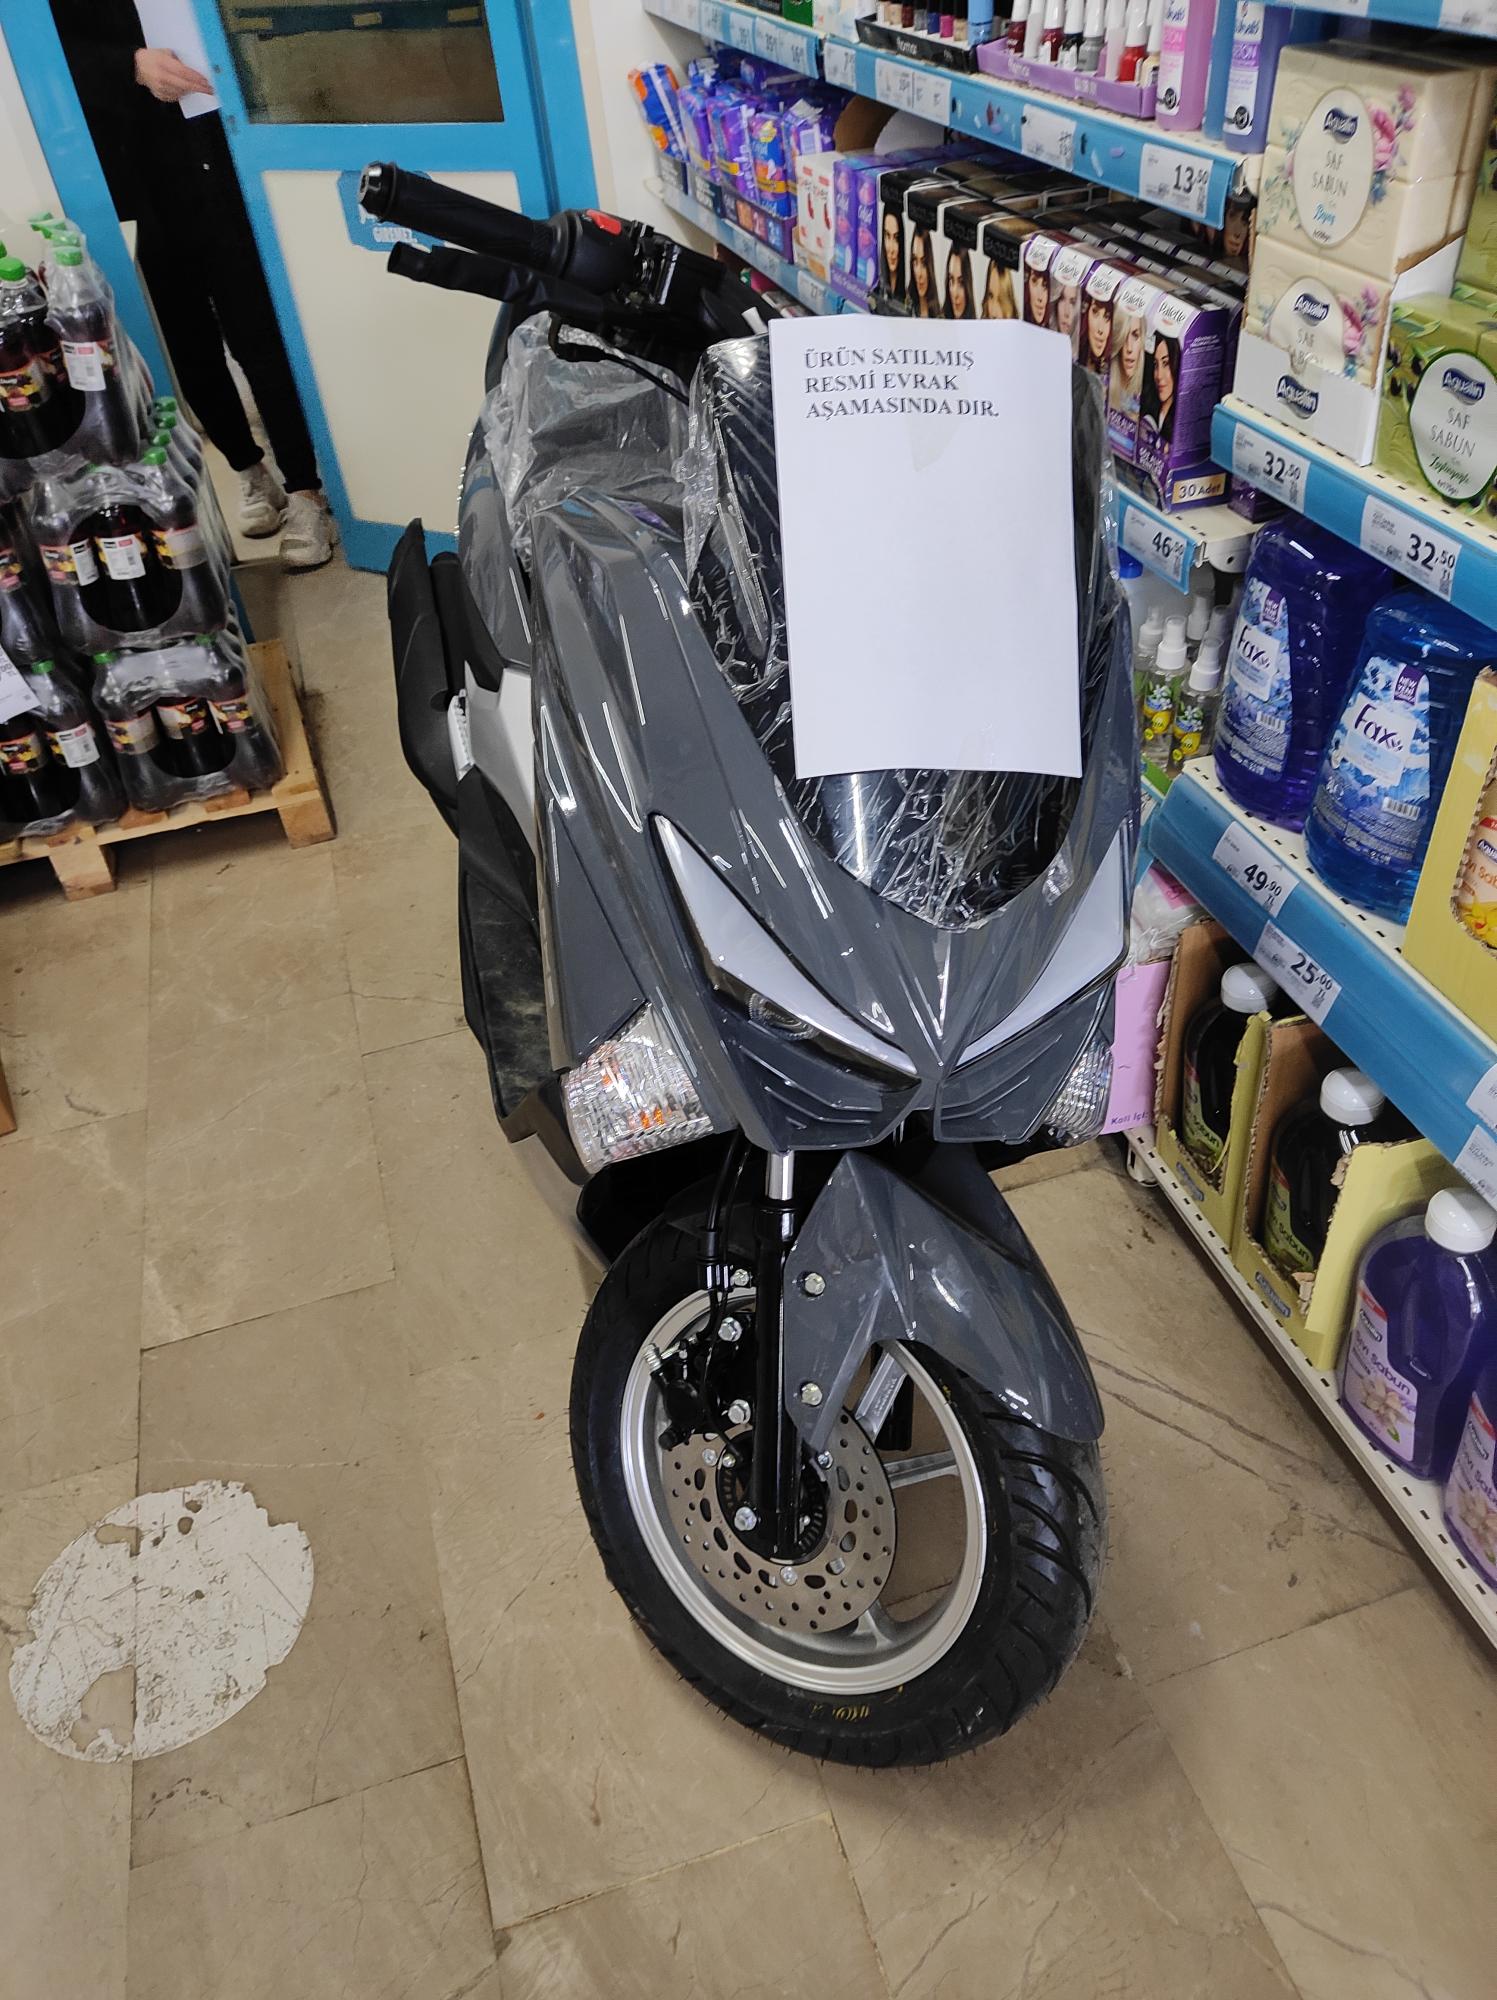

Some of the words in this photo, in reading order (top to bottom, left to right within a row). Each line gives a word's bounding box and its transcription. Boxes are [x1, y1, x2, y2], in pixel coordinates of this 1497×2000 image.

[1326, 150, 1343, 171] SAF
[1312, 172, 1348, 196] SABUN
[1158, 301, 1186, 323] Palette
[804, 346, 866, 368] ÜRÜN
[872, 348, 975, 371] SATILMIŞ
[805, 370, 876, 393] RESMİ
[883, 373, 959, 391] EVRAK
[806, 397, 952, 421] AŞAMASINDA
[956, 399, 999, 417] DIR.
[1447, 407, 1470, 430] SAF
[1430, 424, 1475, 458] SABUN
[1178, 484, 1196, 499] 30
[1197, 482, 1221, 496] Adet
[1237, 625, 1267, 664] Fax
[1354, 703, 1398, 748] Fax
[1370, 1352, 1411, 1396] Sabun
